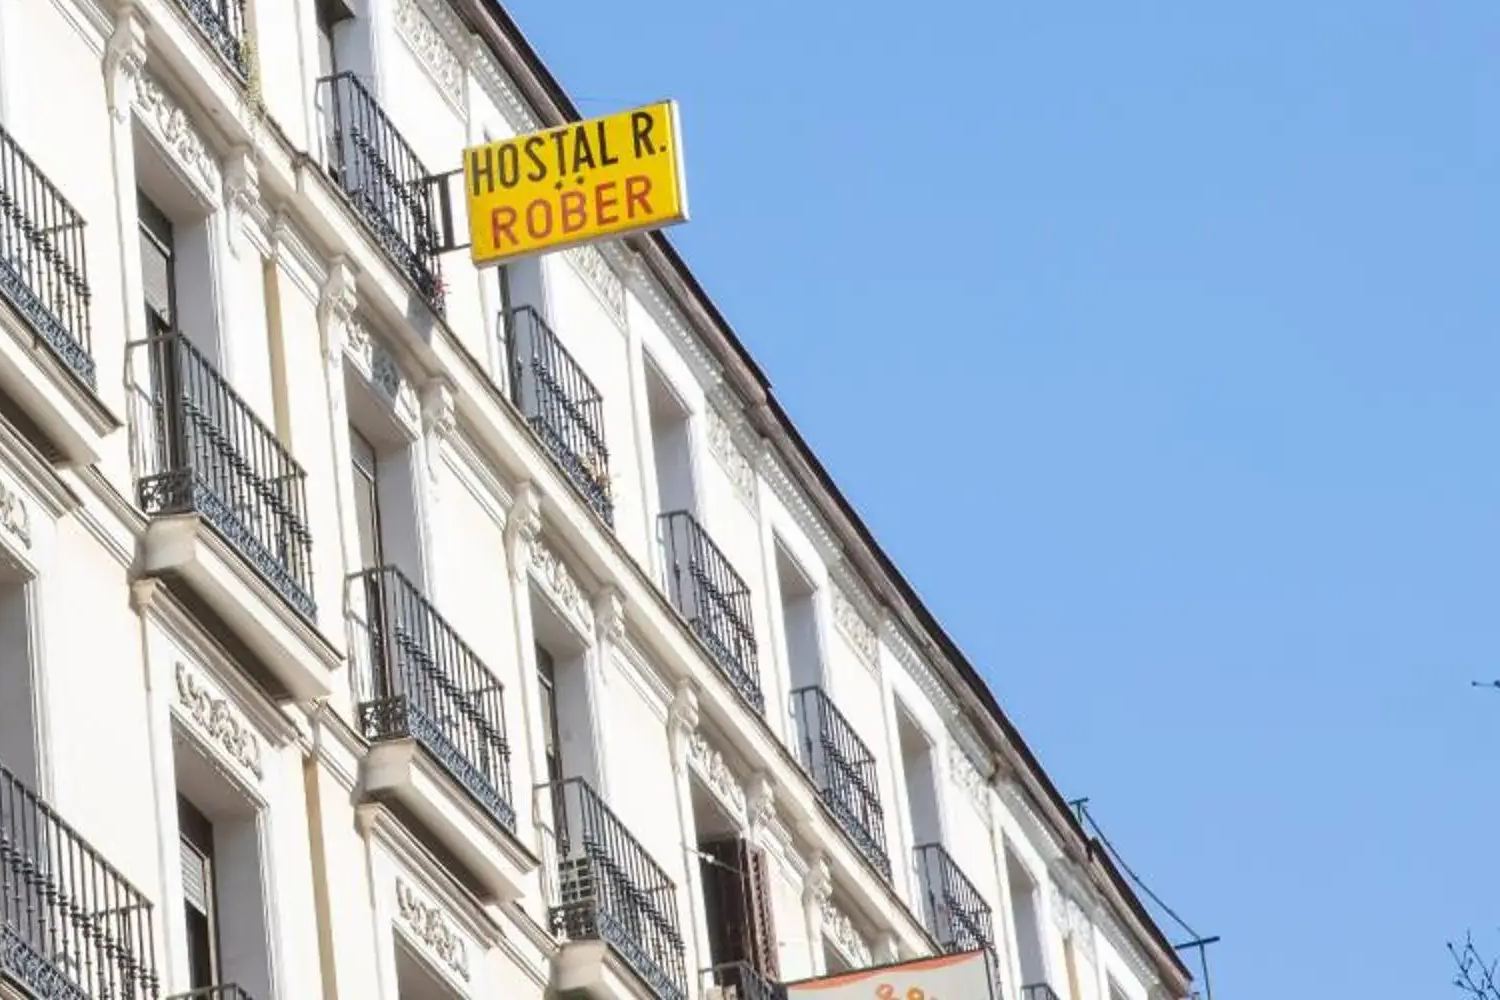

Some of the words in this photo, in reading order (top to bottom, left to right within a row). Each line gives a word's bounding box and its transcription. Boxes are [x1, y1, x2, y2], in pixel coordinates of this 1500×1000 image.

[471, 120, 618, 196] HOSTAL
[631, 111, 667, 159] R.
[490, 175, 654, 249] ROBER
